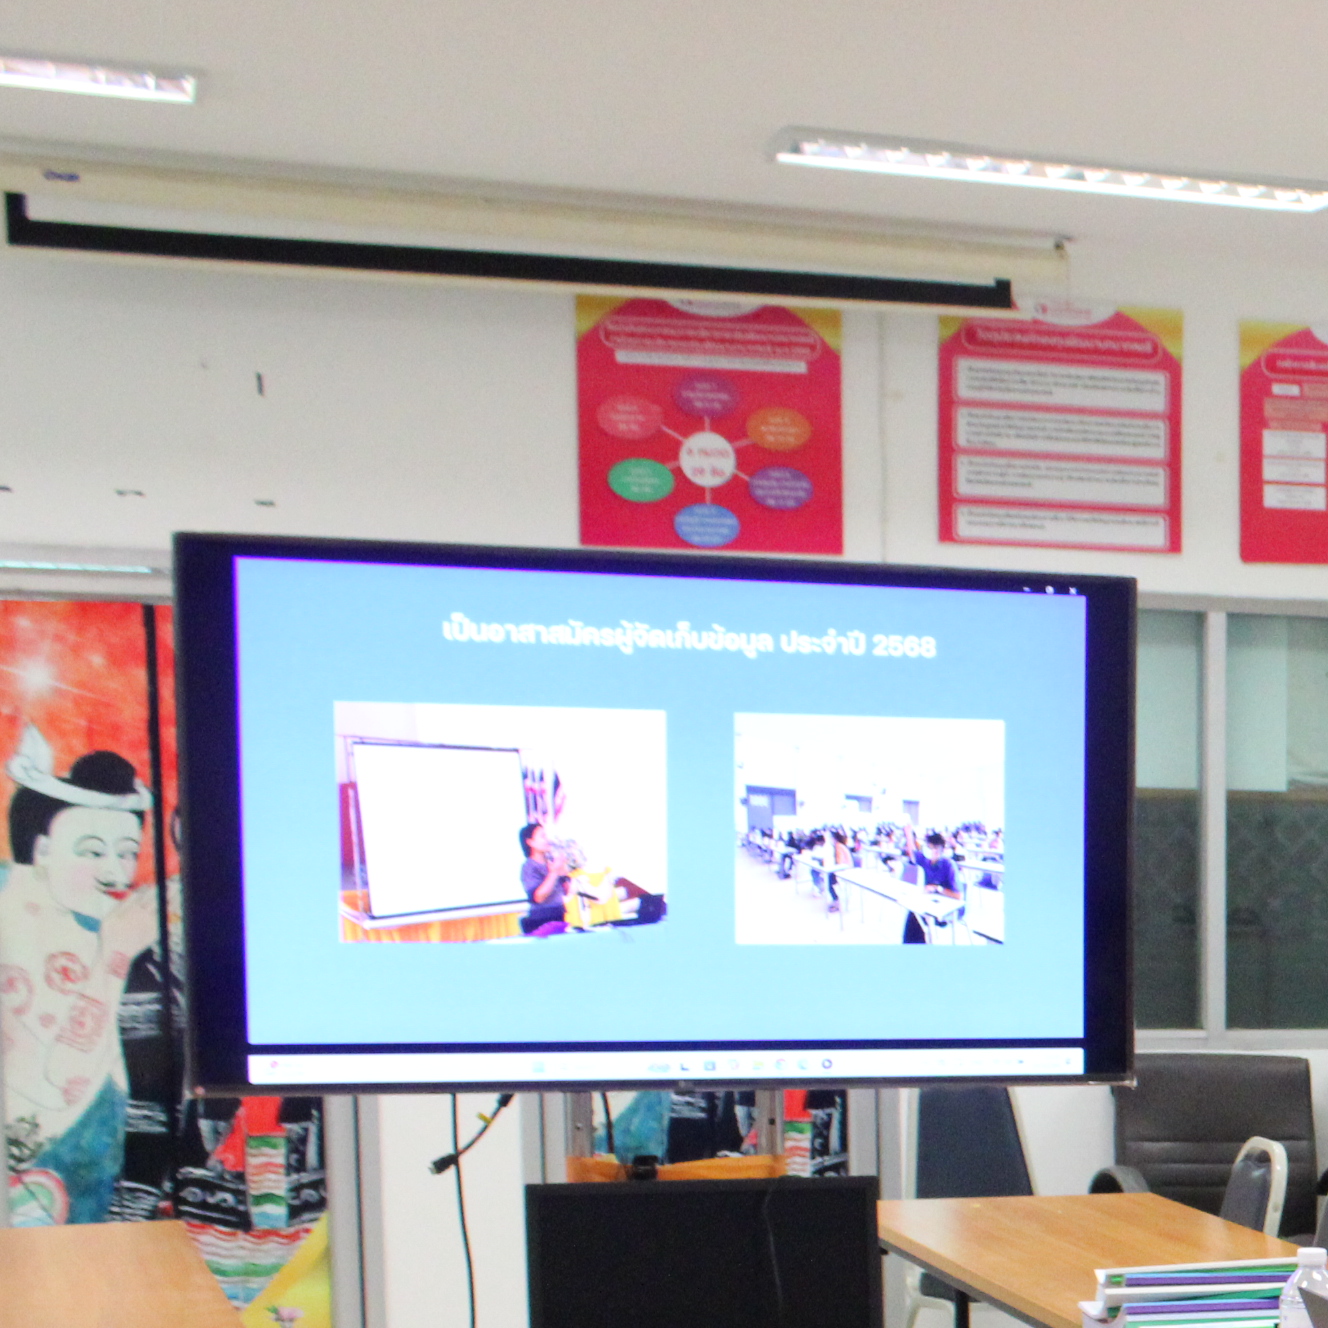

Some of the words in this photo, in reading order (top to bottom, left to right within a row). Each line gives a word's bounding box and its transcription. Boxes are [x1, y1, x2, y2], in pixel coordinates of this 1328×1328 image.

[442, 612, 773, 658] เป็นอาสาสมัครผู้จัดเก็บข้อมูล
[781, 628, 866, 657] ประจำปี
[872, 633, 937, 658] 2568
